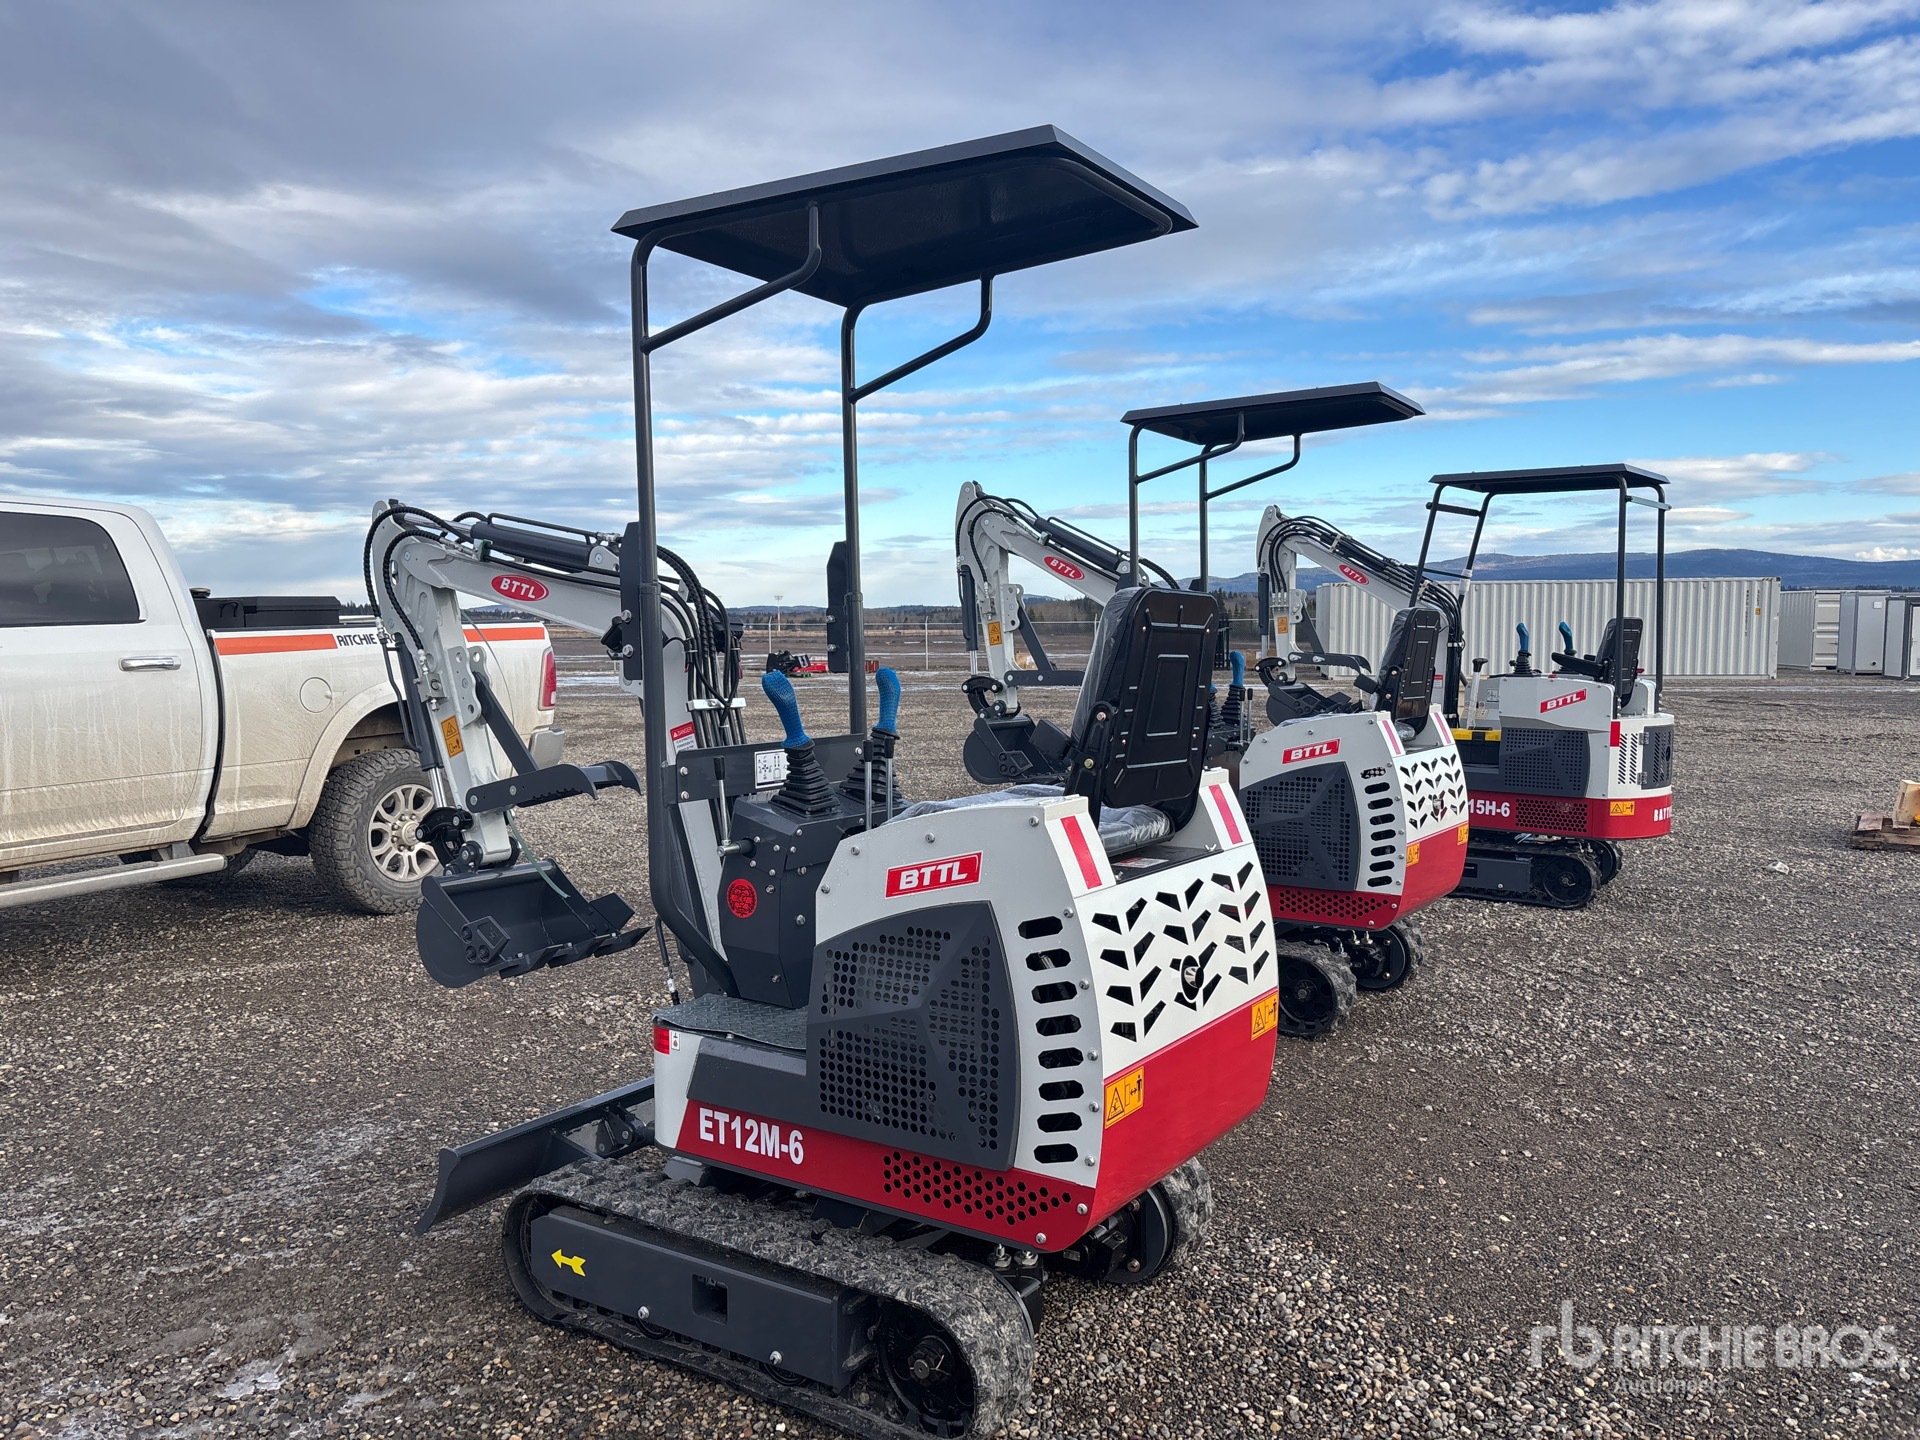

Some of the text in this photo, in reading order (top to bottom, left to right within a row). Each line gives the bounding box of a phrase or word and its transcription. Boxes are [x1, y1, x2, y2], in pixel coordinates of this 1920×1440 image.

[1050, 559, 1076, 578] BTTL
[1343, 566, 1363, 583] BTTL
[500, 577, 536, 599] BTTL
[336, 633, 377, 647] RITCHIE
[1546, 693, 1581, 710] BTTL
[1290, 743, 1332, 760] BTTL
[1468, 798, 1510, 818] 15H-6
[1653, 806, 1672, 822] BATT
[899, 861, 968, 890] BTTL
[699, 1107, 804, 1165] ET12M-6
